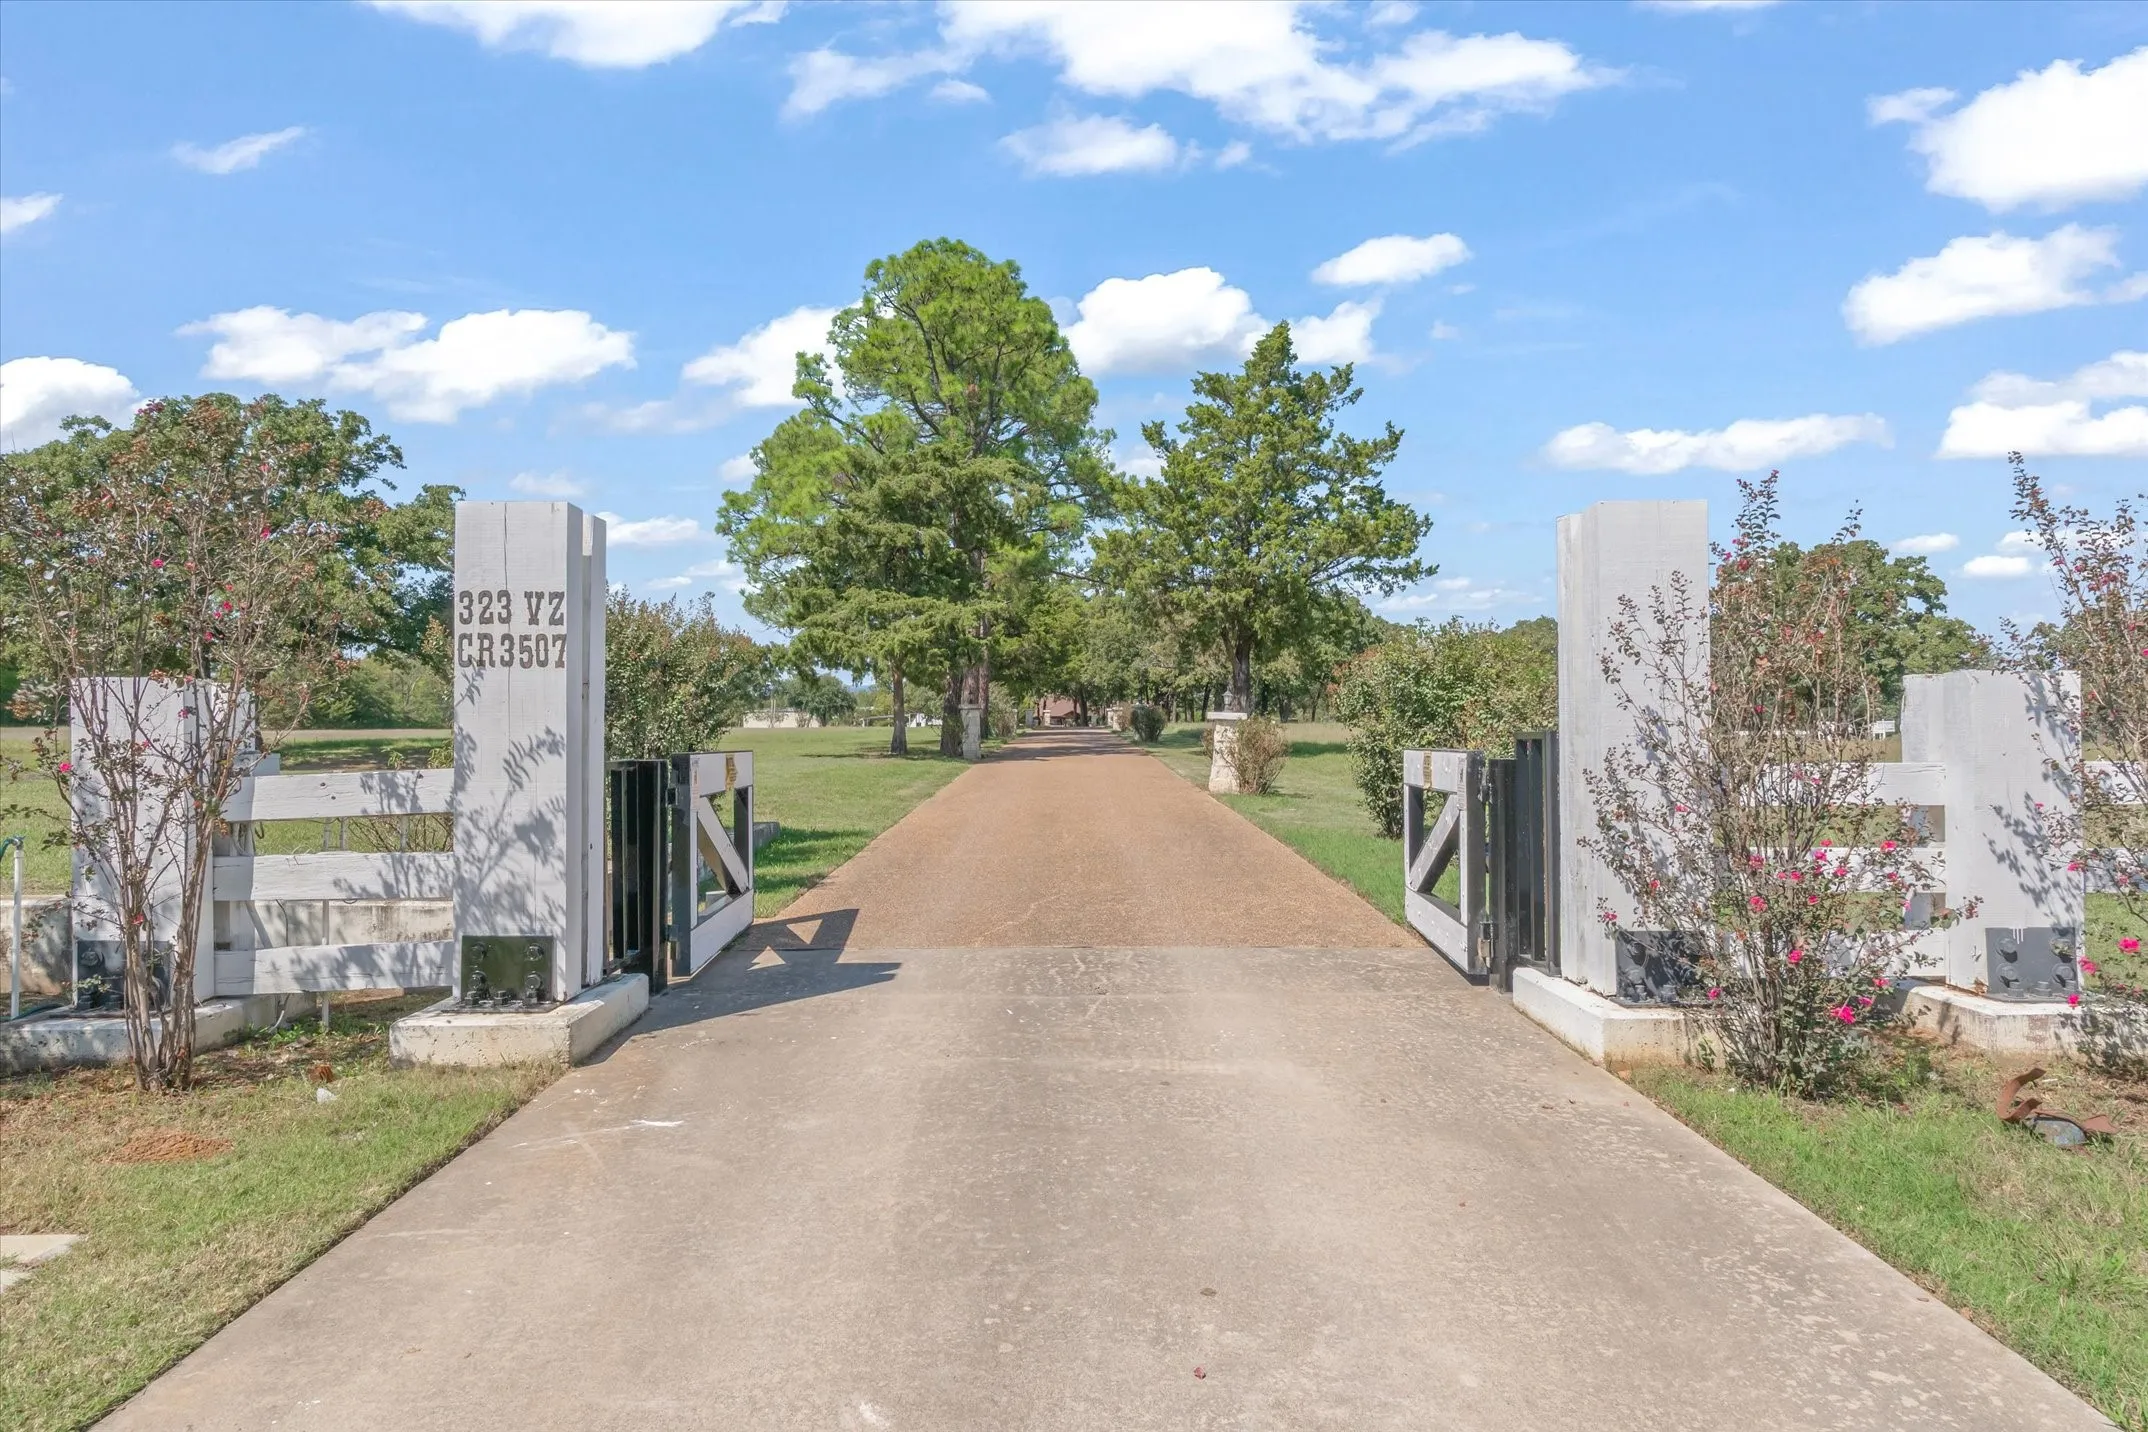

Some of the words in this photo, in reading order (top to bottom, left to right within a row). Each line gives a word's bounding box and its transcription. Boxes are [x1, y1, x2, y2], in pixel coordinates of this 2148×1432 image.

[459, 589, 512, 625] 323
[524, 591, 565, 626] VZ
[457, 632, 567, 669] CR3507
